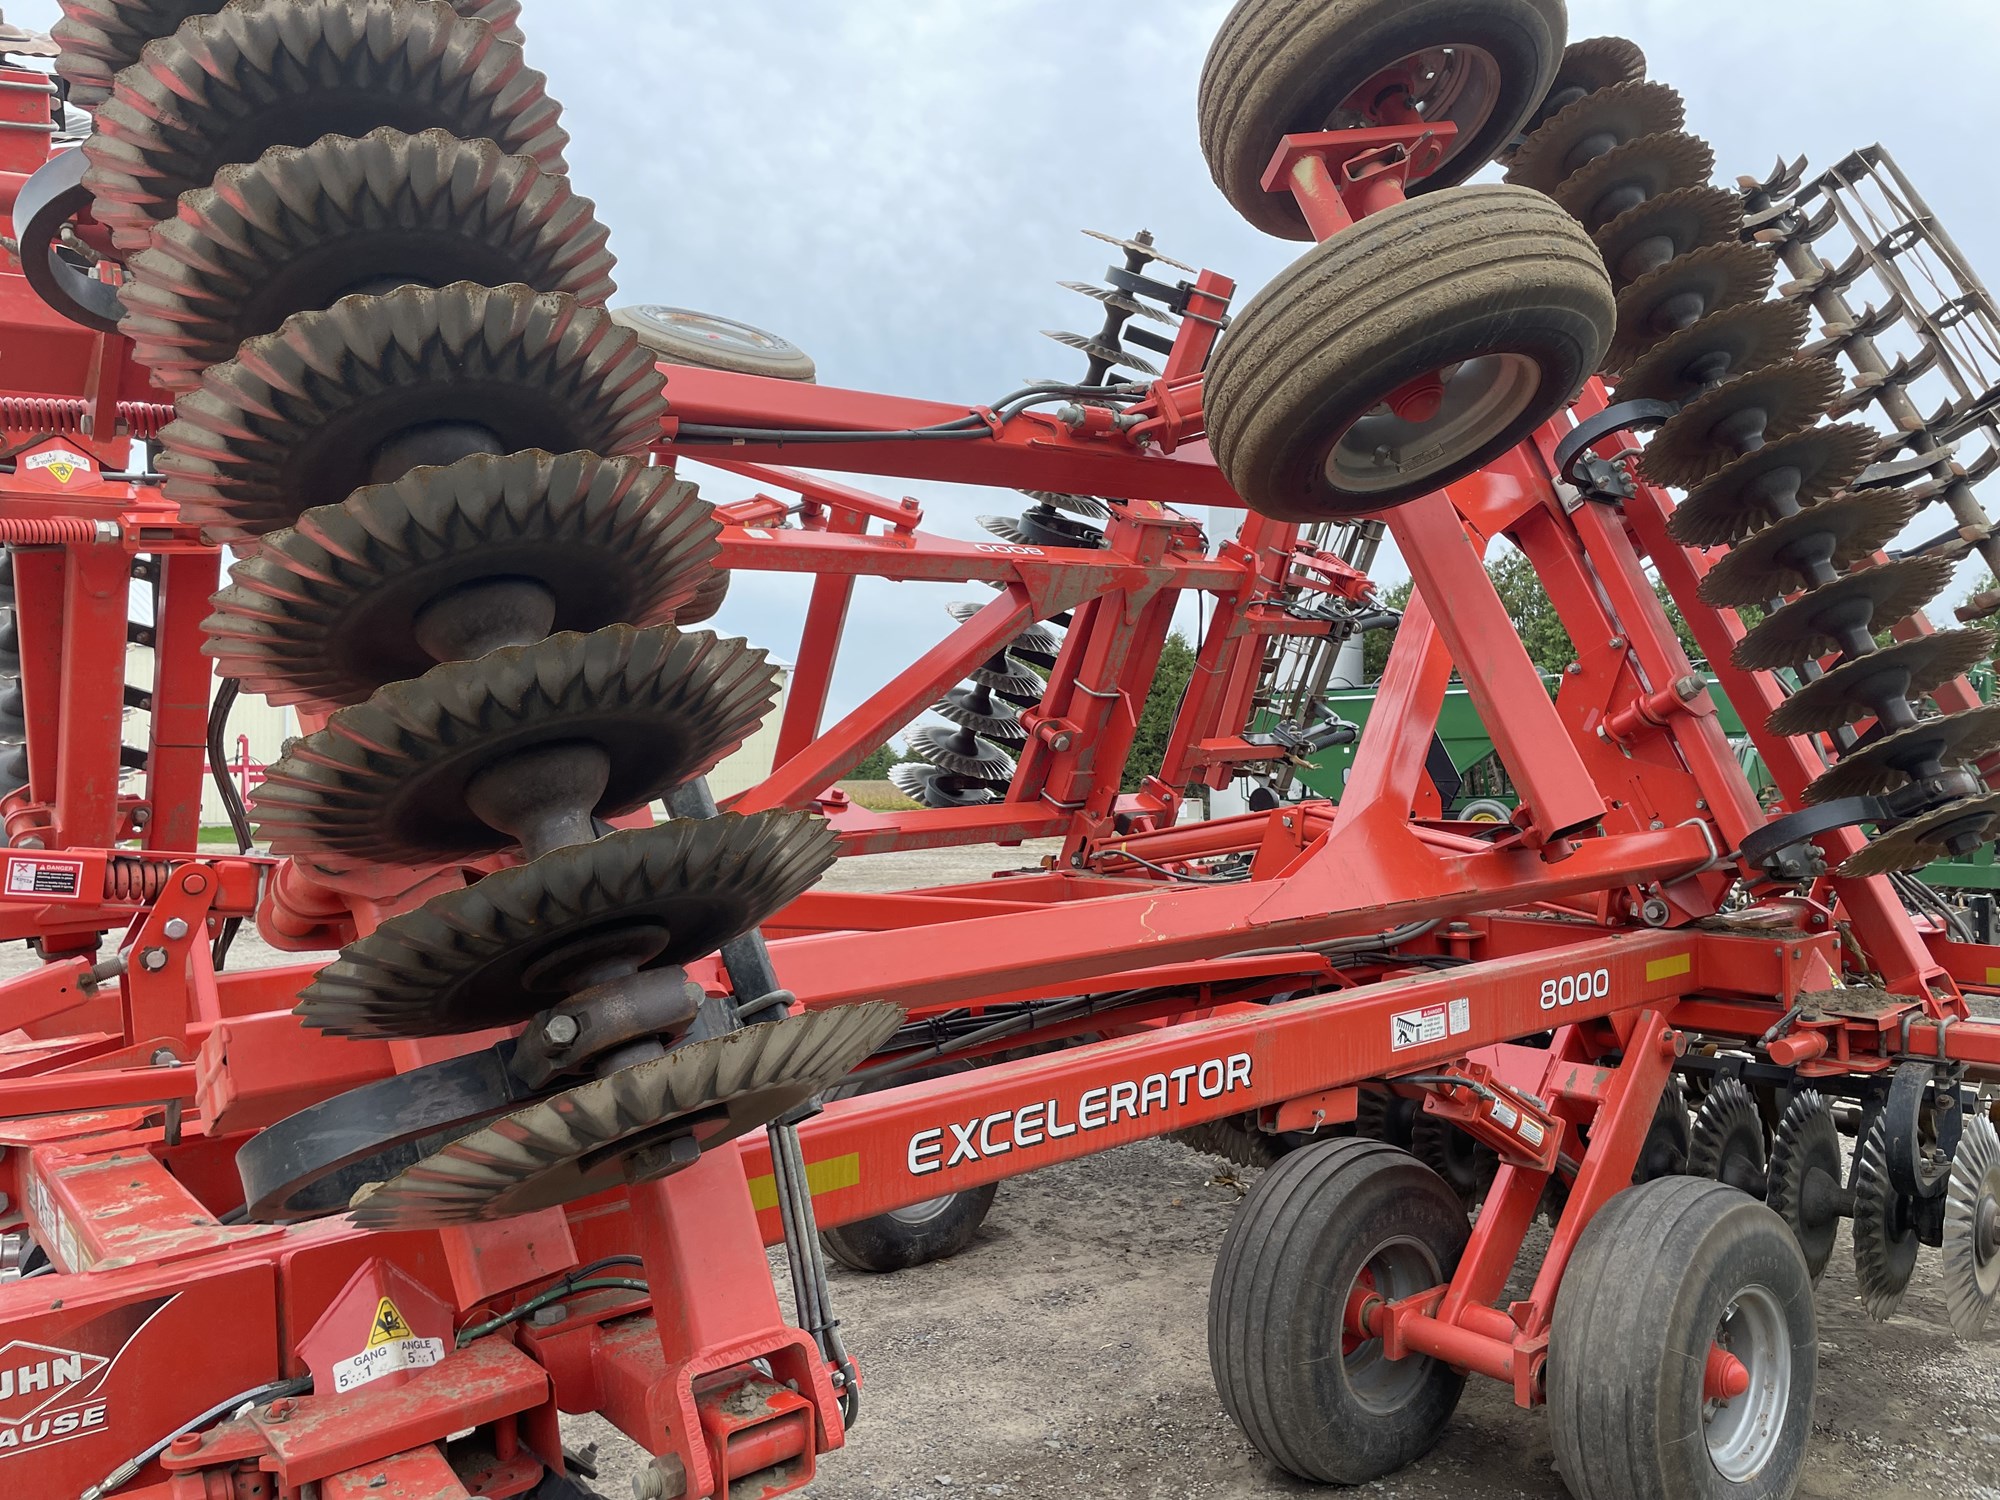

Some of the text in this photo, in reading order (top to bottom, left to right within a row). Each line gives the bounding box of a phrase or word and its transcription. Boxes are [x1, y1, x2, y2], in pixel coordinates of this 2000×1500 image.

[974, 544, 1045, 555] 8000
[1540, 968, 1609, 1010] 8000
[907, 1052, 1253, 1176] EXCELERATOR
[353, 1339, 431, 1367] GANG ANGLE
